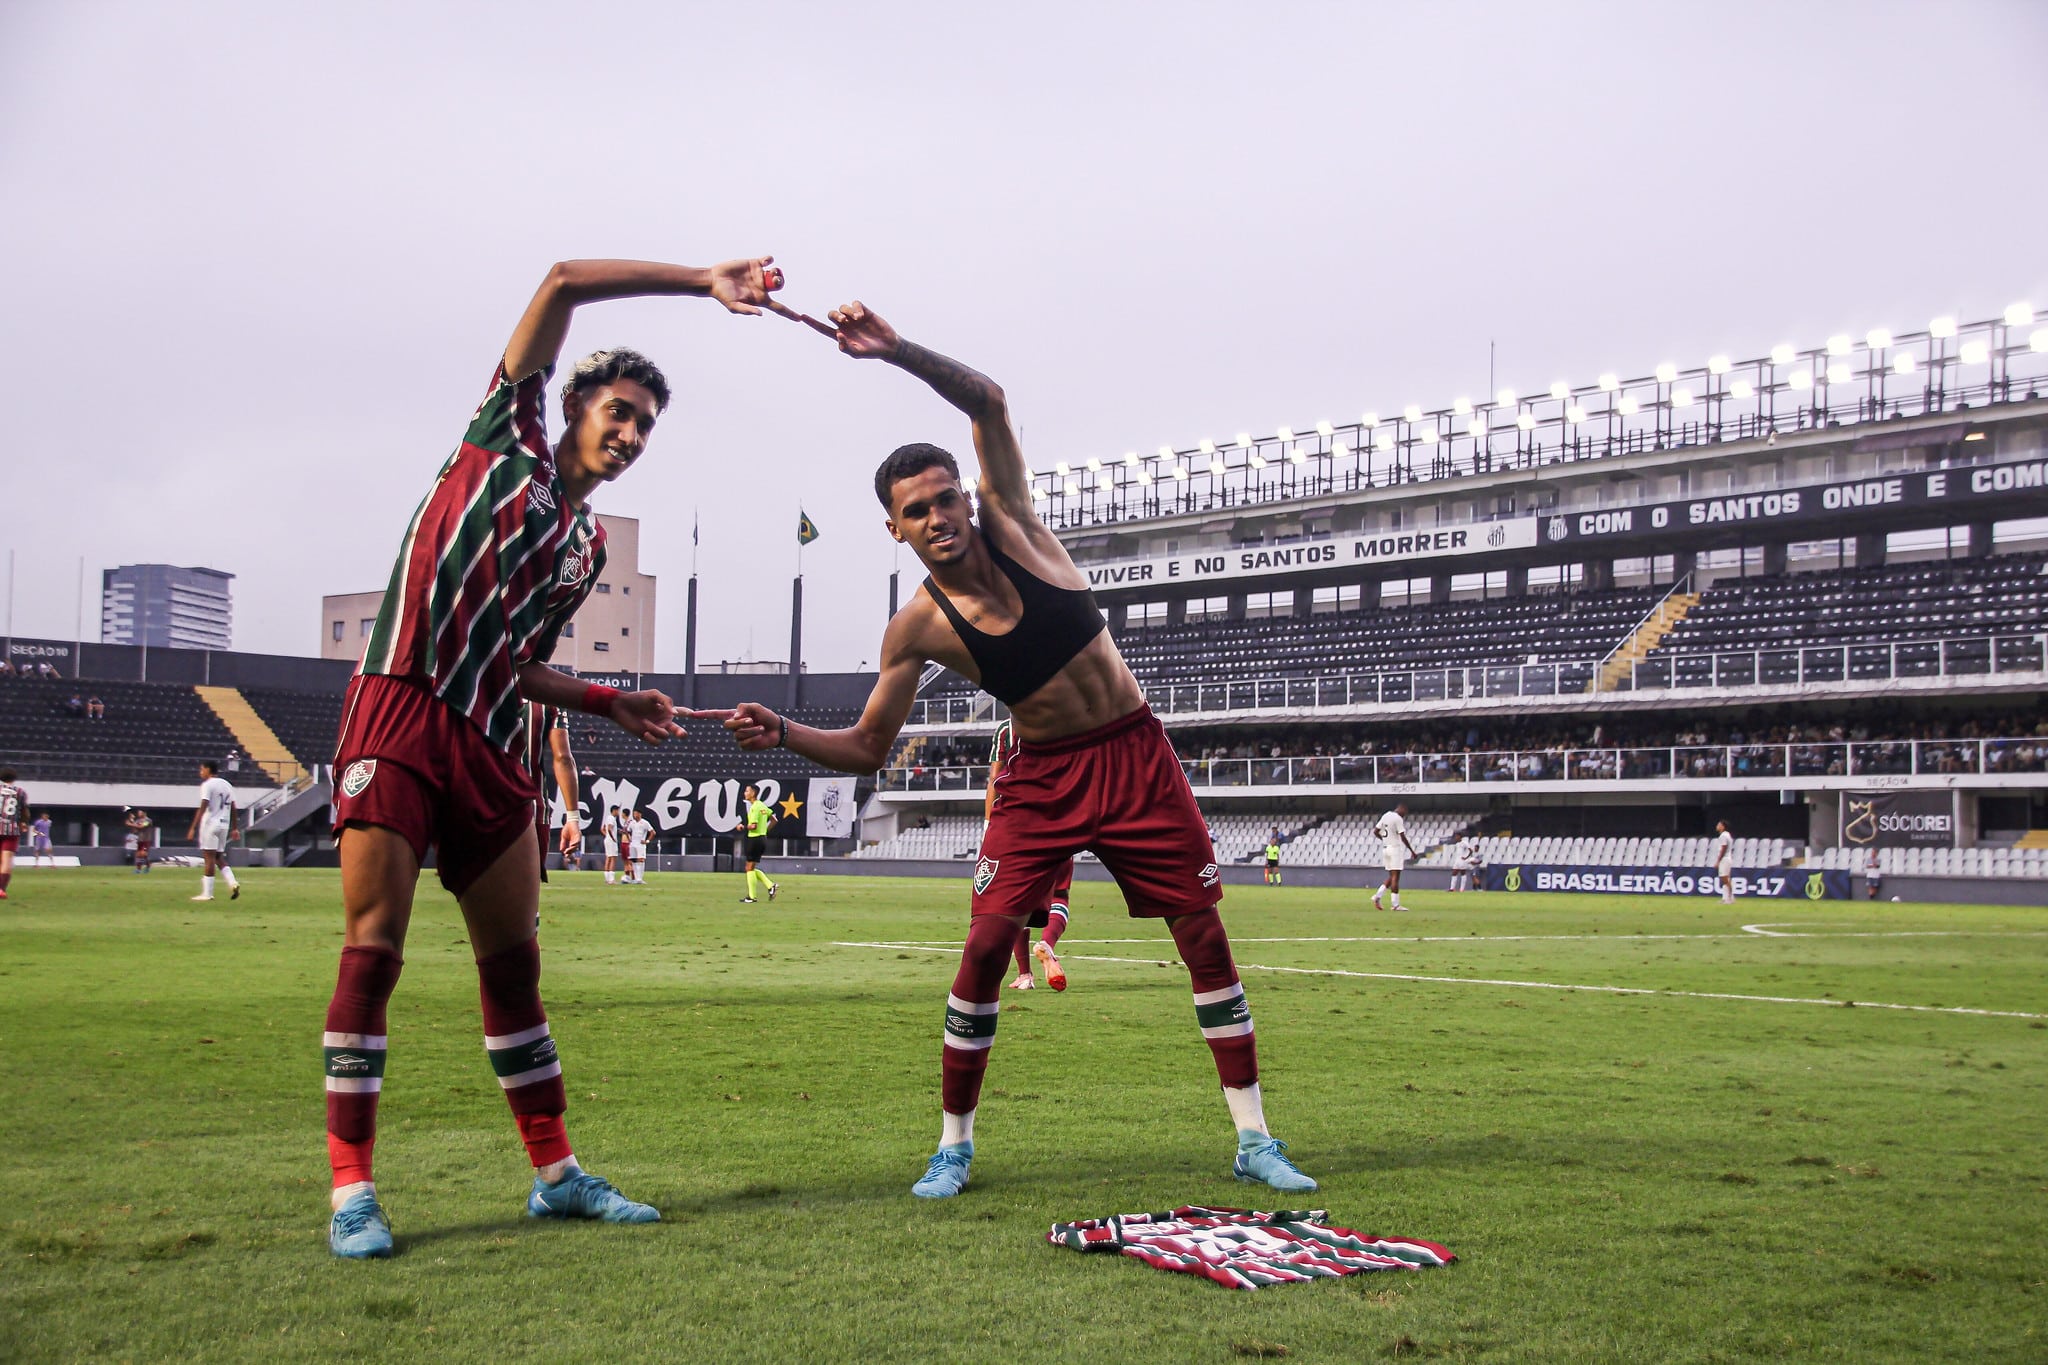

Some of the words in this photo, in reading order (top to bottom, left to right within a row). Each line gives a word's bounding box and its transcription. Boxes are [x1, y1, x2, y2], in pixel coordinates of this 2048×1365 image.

[1579, 510, 1632, 536] COM
[1651, 507, 1668, 528] O
[1689, 492, 1800, 524] SANTOS
[1823, 479, 1903, 509] ONDE
[1926, 473, 1946, 498] E
[1972, 462, 2048, 493] COM
[1088, 564, 1153, 585] VIVER
[1168, 561, 1180, 577] E
[1195, 556, 1225, 574] NO
[1241, 544, 1336, 570] SANTOS
[1354, 530, 1468, 558] MORRER
[1536, 870, 1695, 894] BRASILEIRÃO
